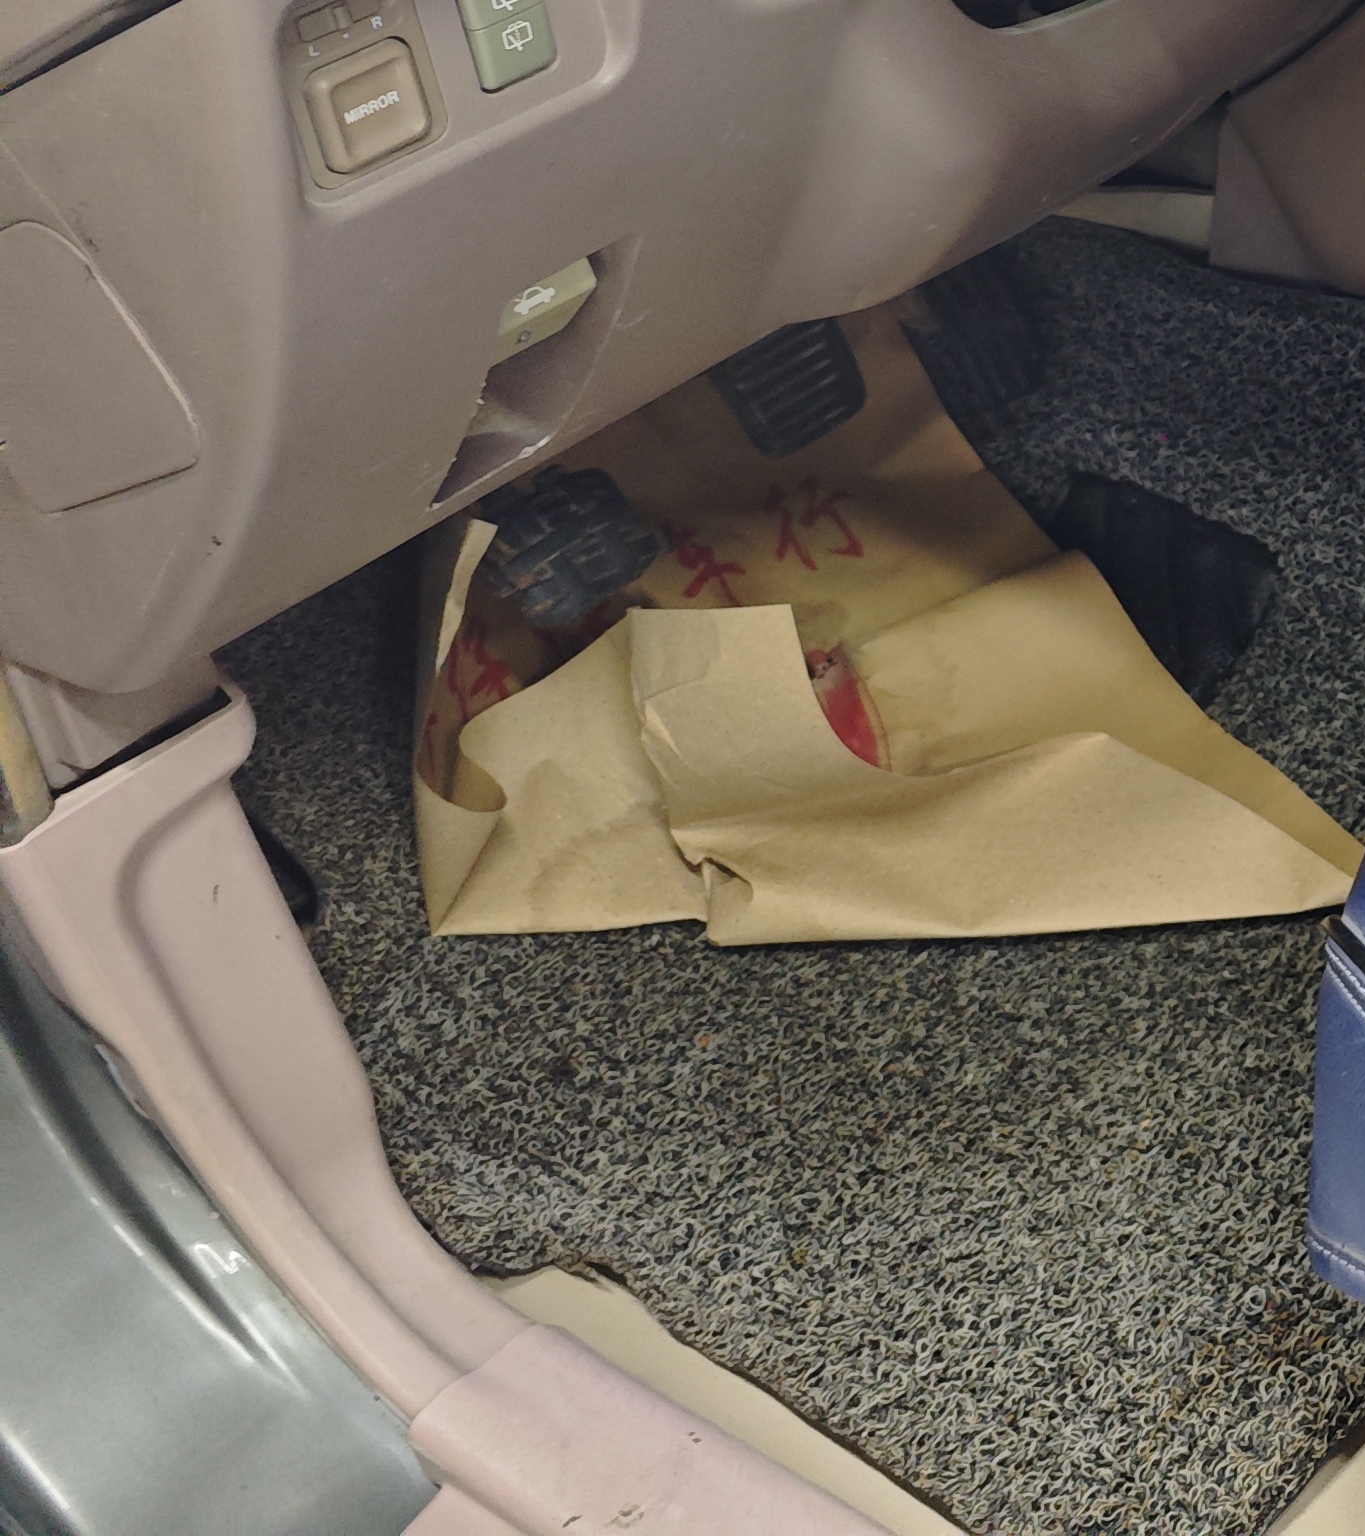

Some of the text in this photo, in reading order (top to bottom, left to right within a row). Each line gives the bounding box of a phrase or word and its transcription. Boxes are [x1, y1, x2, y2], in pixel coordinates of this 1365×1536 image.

[370, 15, 383, 30] R
[308, 45, 320, 57] L
[343, 90, 400, 125] MIRROR
